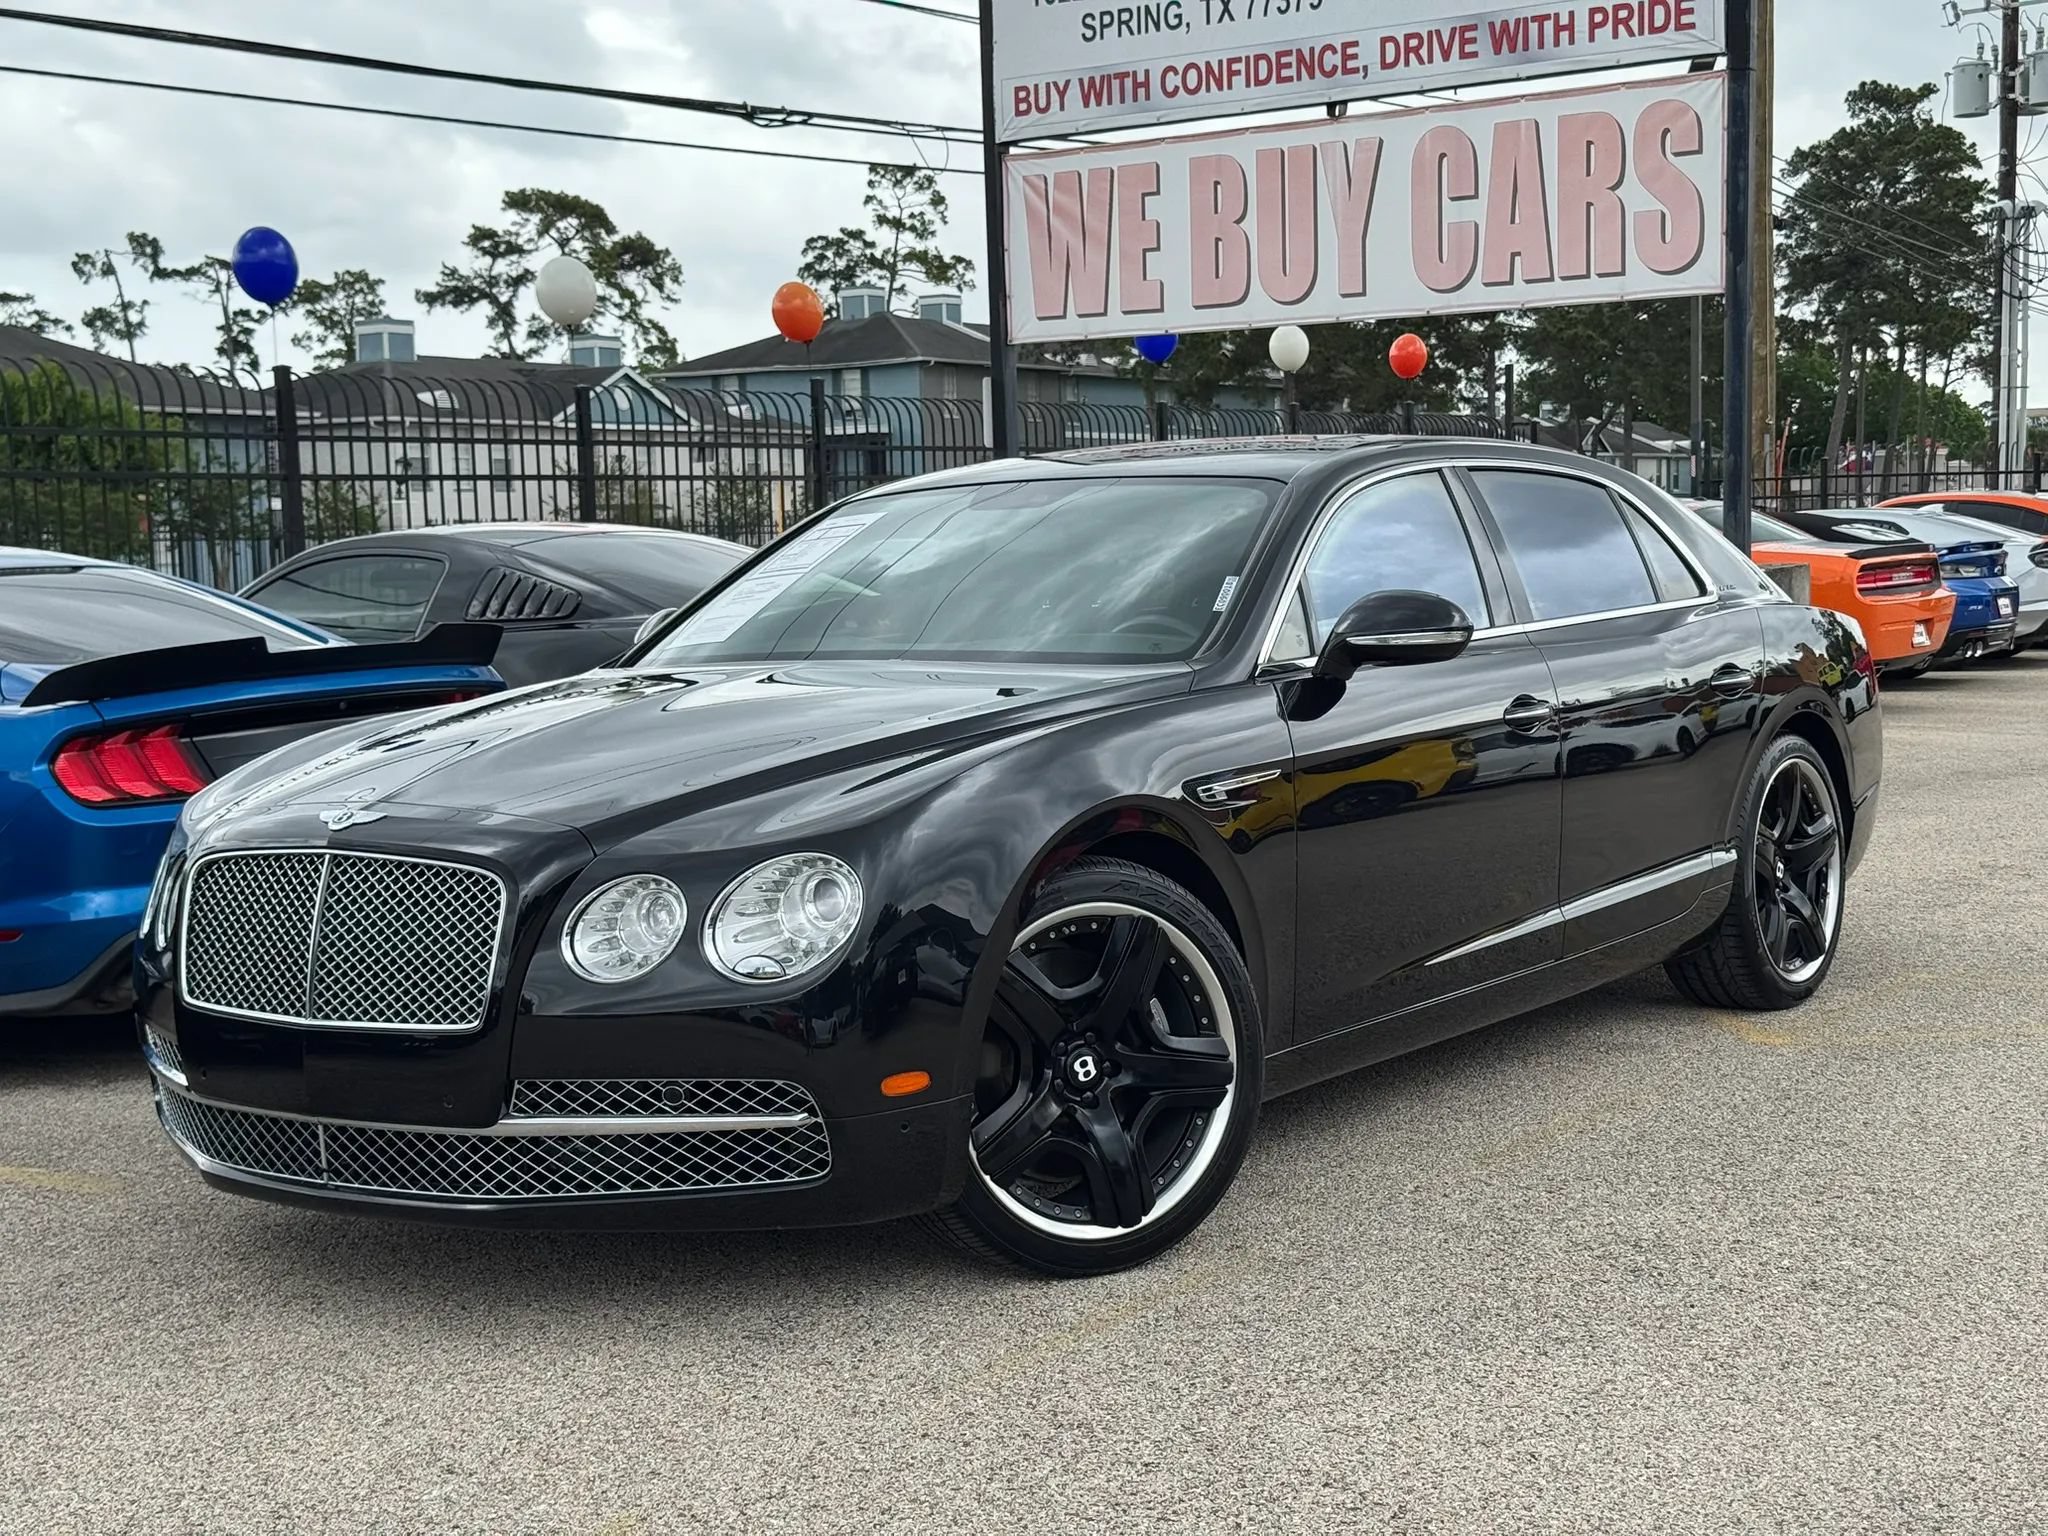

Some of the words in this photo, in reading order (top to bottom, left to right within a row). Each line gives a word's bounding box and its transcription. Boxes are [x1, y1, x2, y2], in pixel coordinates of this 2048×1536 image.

[1013, 79, 1071, 118] BUY
[1078, 69, 1150, 109] WITH
[1160, 40, 1369, 99] CONFIDENCE,
[1379, 23, 1479, 71] DRIVE
[1487, 10, 1575, 55] WITH
[1587, 0, 1697, 43] PRIDE
[1081, 0, 1191, 43] SPRING,
[1200, 0, 1235, 26] TX
[1022, 162, 1164, 320] WE
[1189, 137, 1384, 310] BUY
[1411, 99, 1704, 293] CARS
[1073, 1055, 1097, 1082] B
